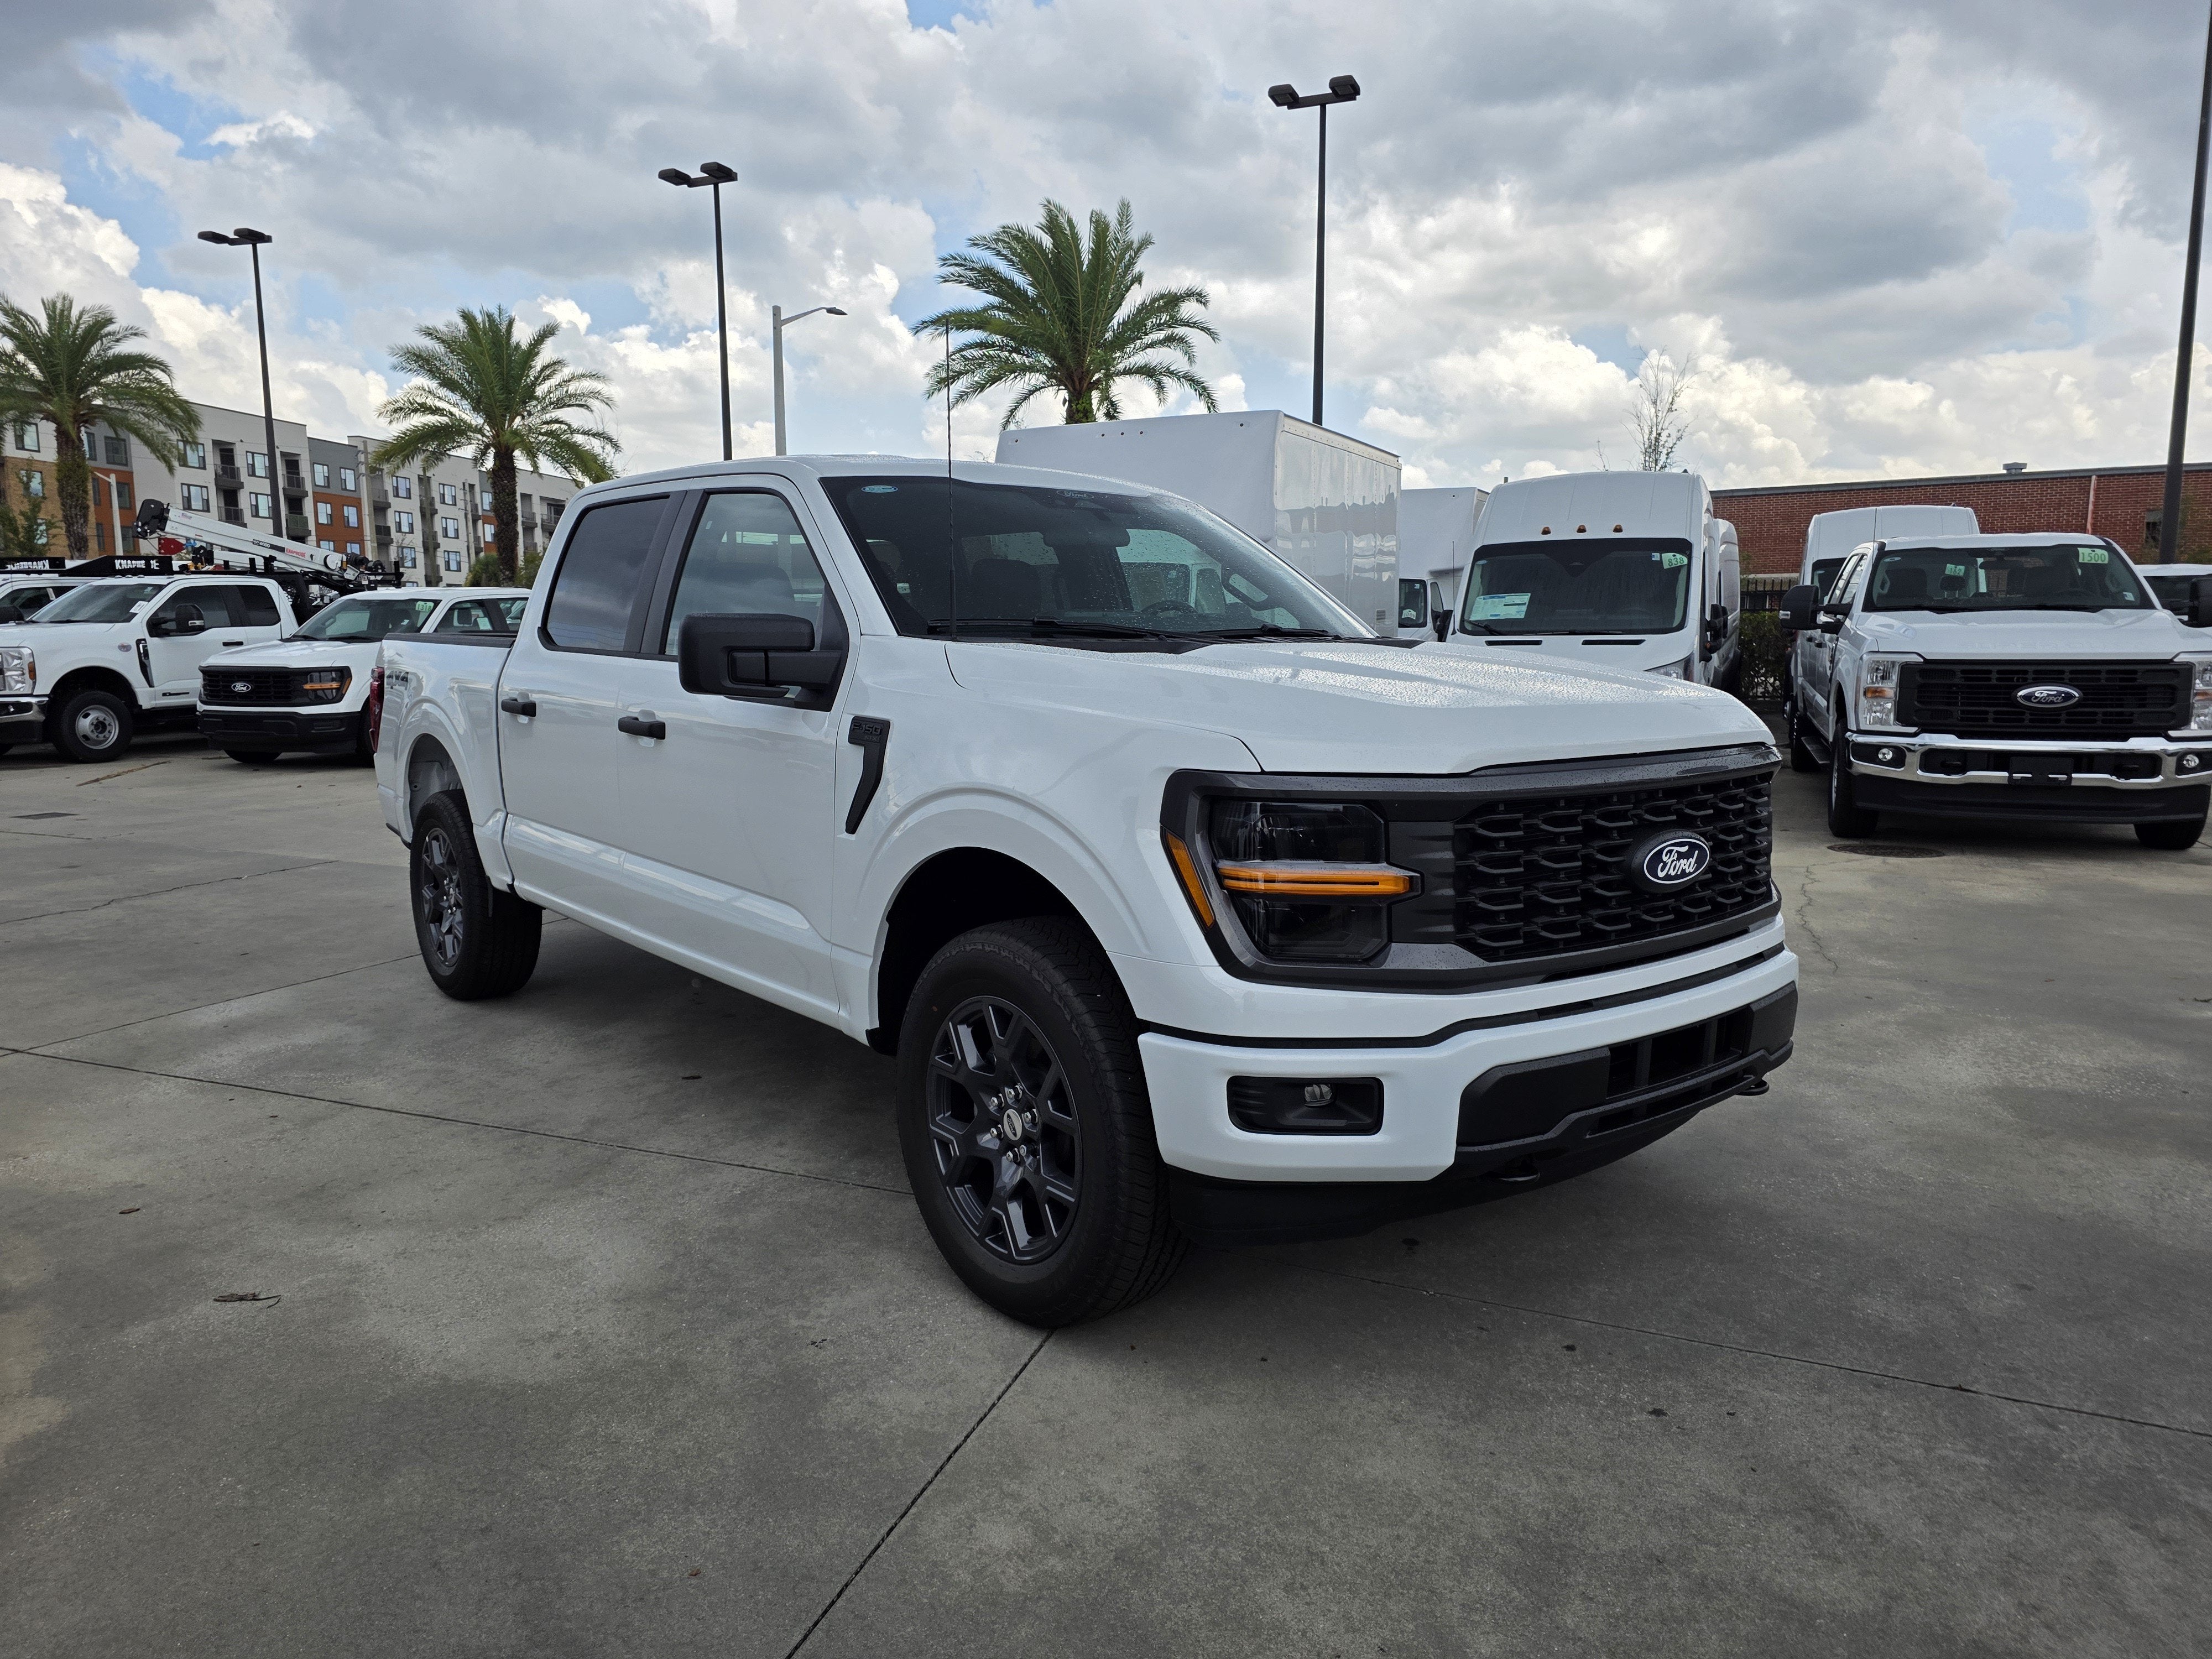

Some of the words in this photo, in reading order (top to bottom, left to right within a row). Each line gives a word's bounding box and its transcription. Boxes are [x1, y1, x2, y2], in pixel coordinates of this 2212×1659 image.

[1667, 557, 1684, 567] 838
[2081, 552, 2106, 562] 1500
[2031, 691, 2065, 703] Ford
[851, 722, 882, 735] F-150
[1657, 845, 1699, 878] Ford
